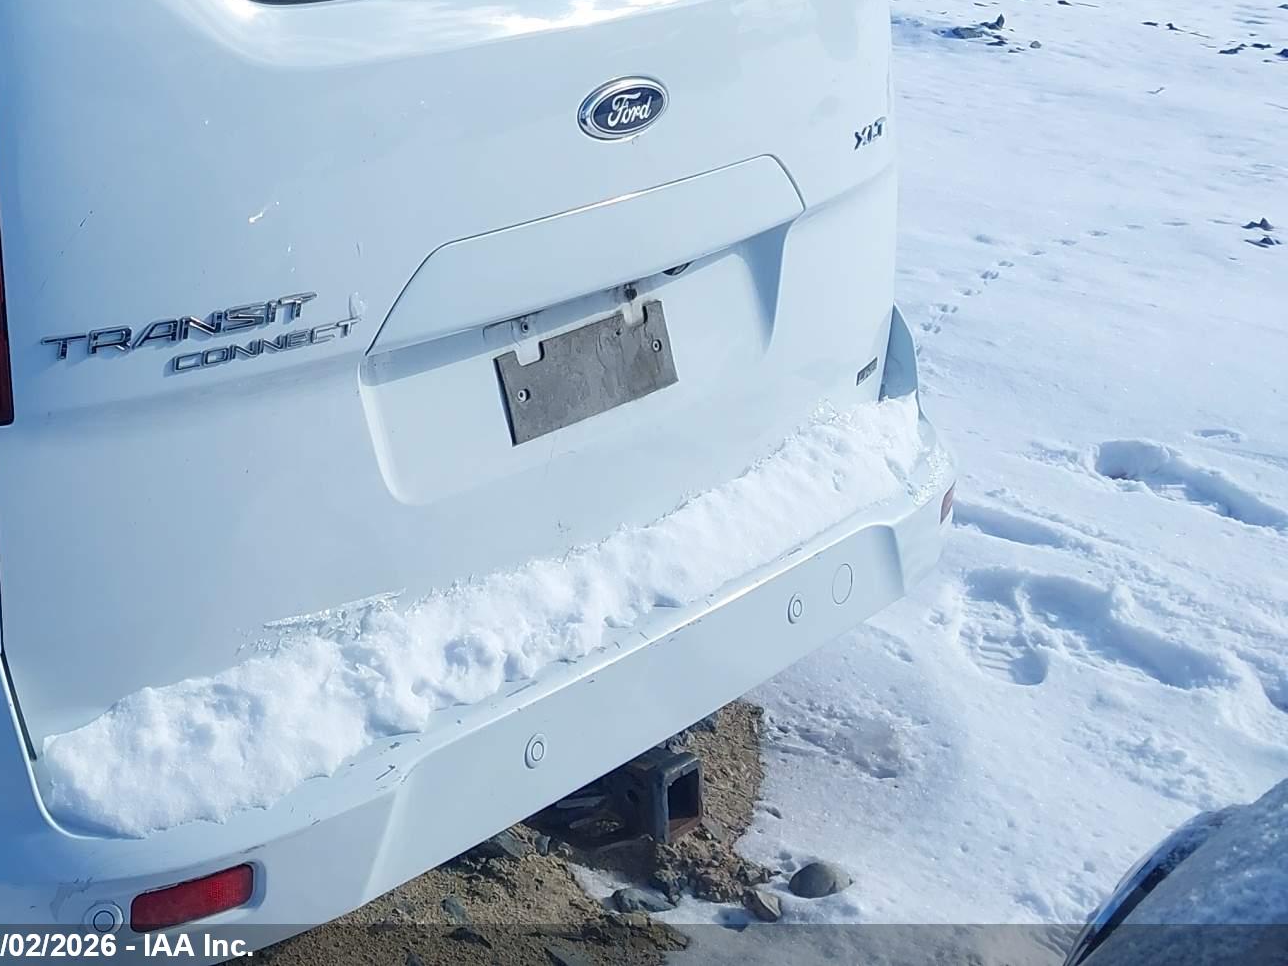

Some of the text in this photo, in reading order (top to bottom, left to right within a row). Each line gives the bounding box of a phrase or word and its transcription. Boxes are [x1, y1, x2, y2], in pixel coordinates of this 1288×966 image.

[607, 92, 652, 127] Ford
[41, 291, 317, 360] TRANSIT
[172, 317, 359, 373] CONNECT
